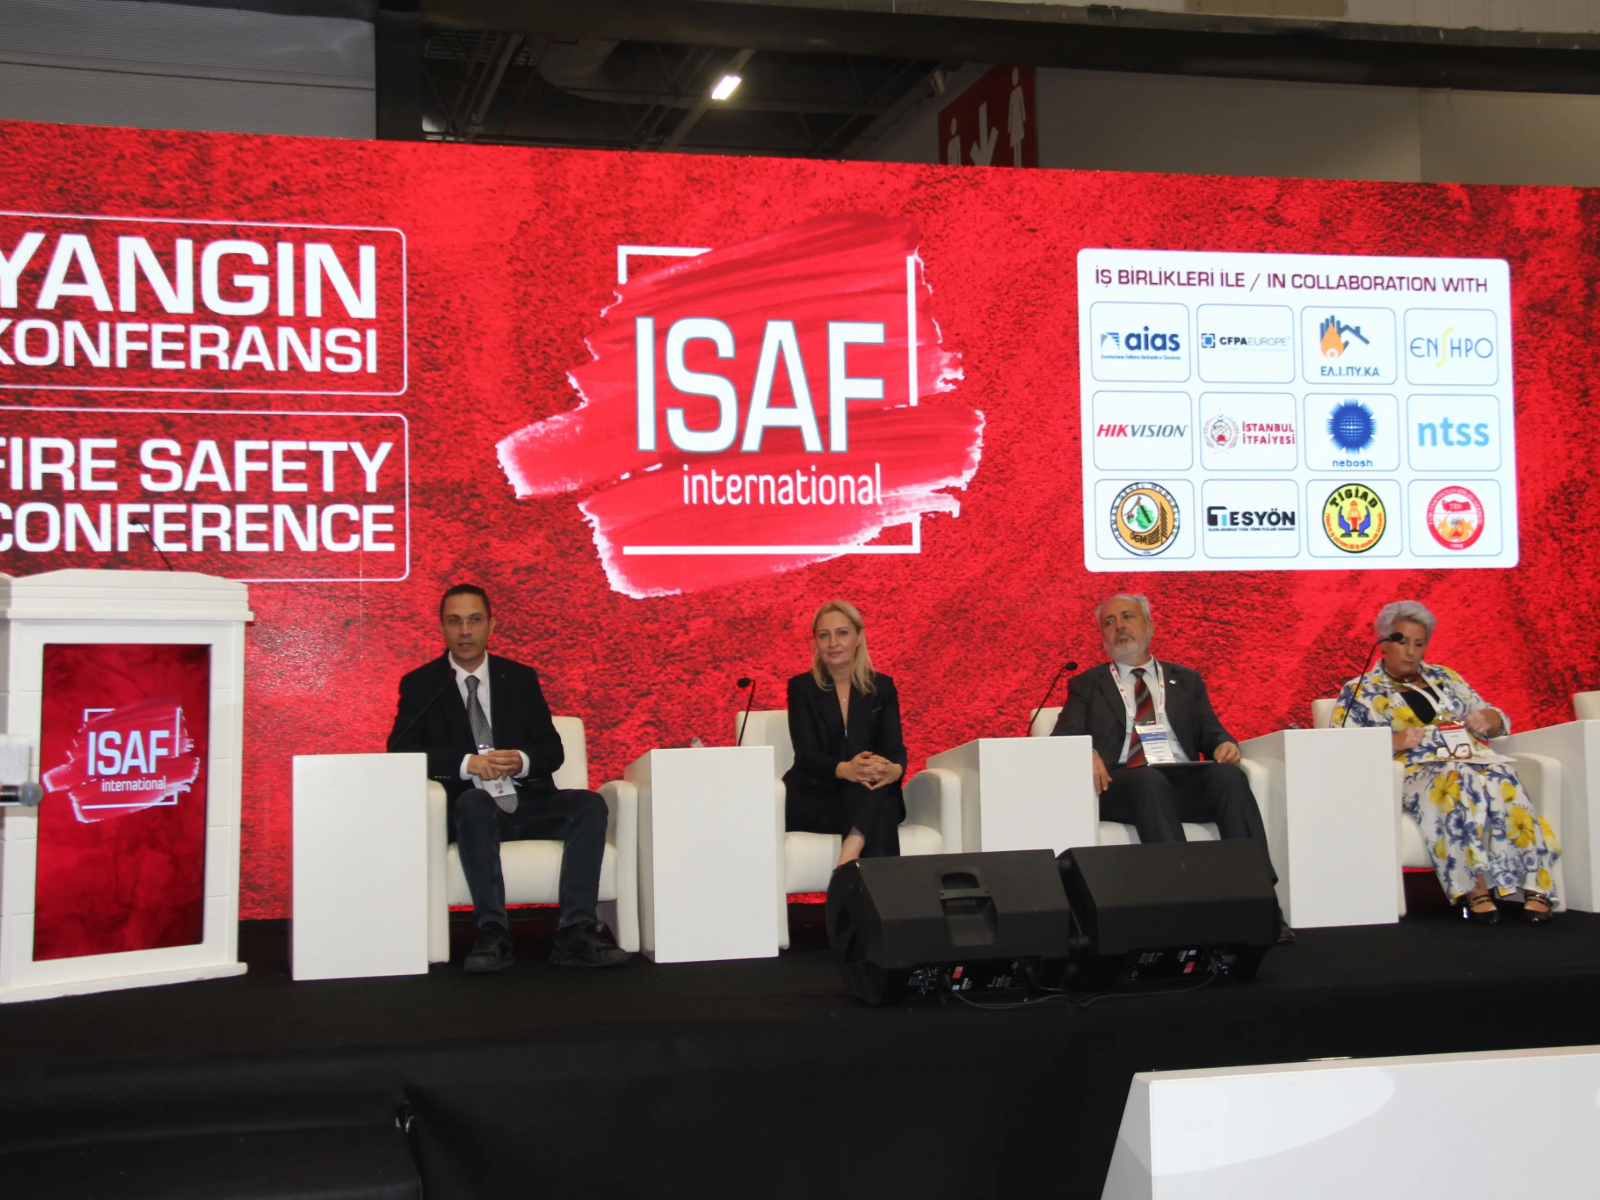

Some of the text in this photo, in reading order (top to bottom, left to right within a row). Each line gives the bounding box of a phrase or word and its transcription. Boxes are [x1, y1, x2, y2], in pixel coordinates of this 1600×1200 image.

[0, 231, 376, 319] YANGIN
[1095, 265, 1488, 292] İŞ BİRLİKLERİ İLE / IN COLLABORATION WITH
[1124, 325, 1181, 351] aias
[635, 316, 886, 454] ISAF
[1096, 424, 1187, 438] HIKVISION
[1242, 421, 1295, 433] İSTANBUL
[1242, 433, 1296, 445] İTFAİYESİ
[1417, 417, 1490, 447] ntss
[0, 437, 393, 493] IRE SAFETY
[1332, 458, 1373, 467] nebosh
[683, 462, 883, 505] international
[88, 730, 169, 776] ISAF
[101, 775, 166, 792] international
